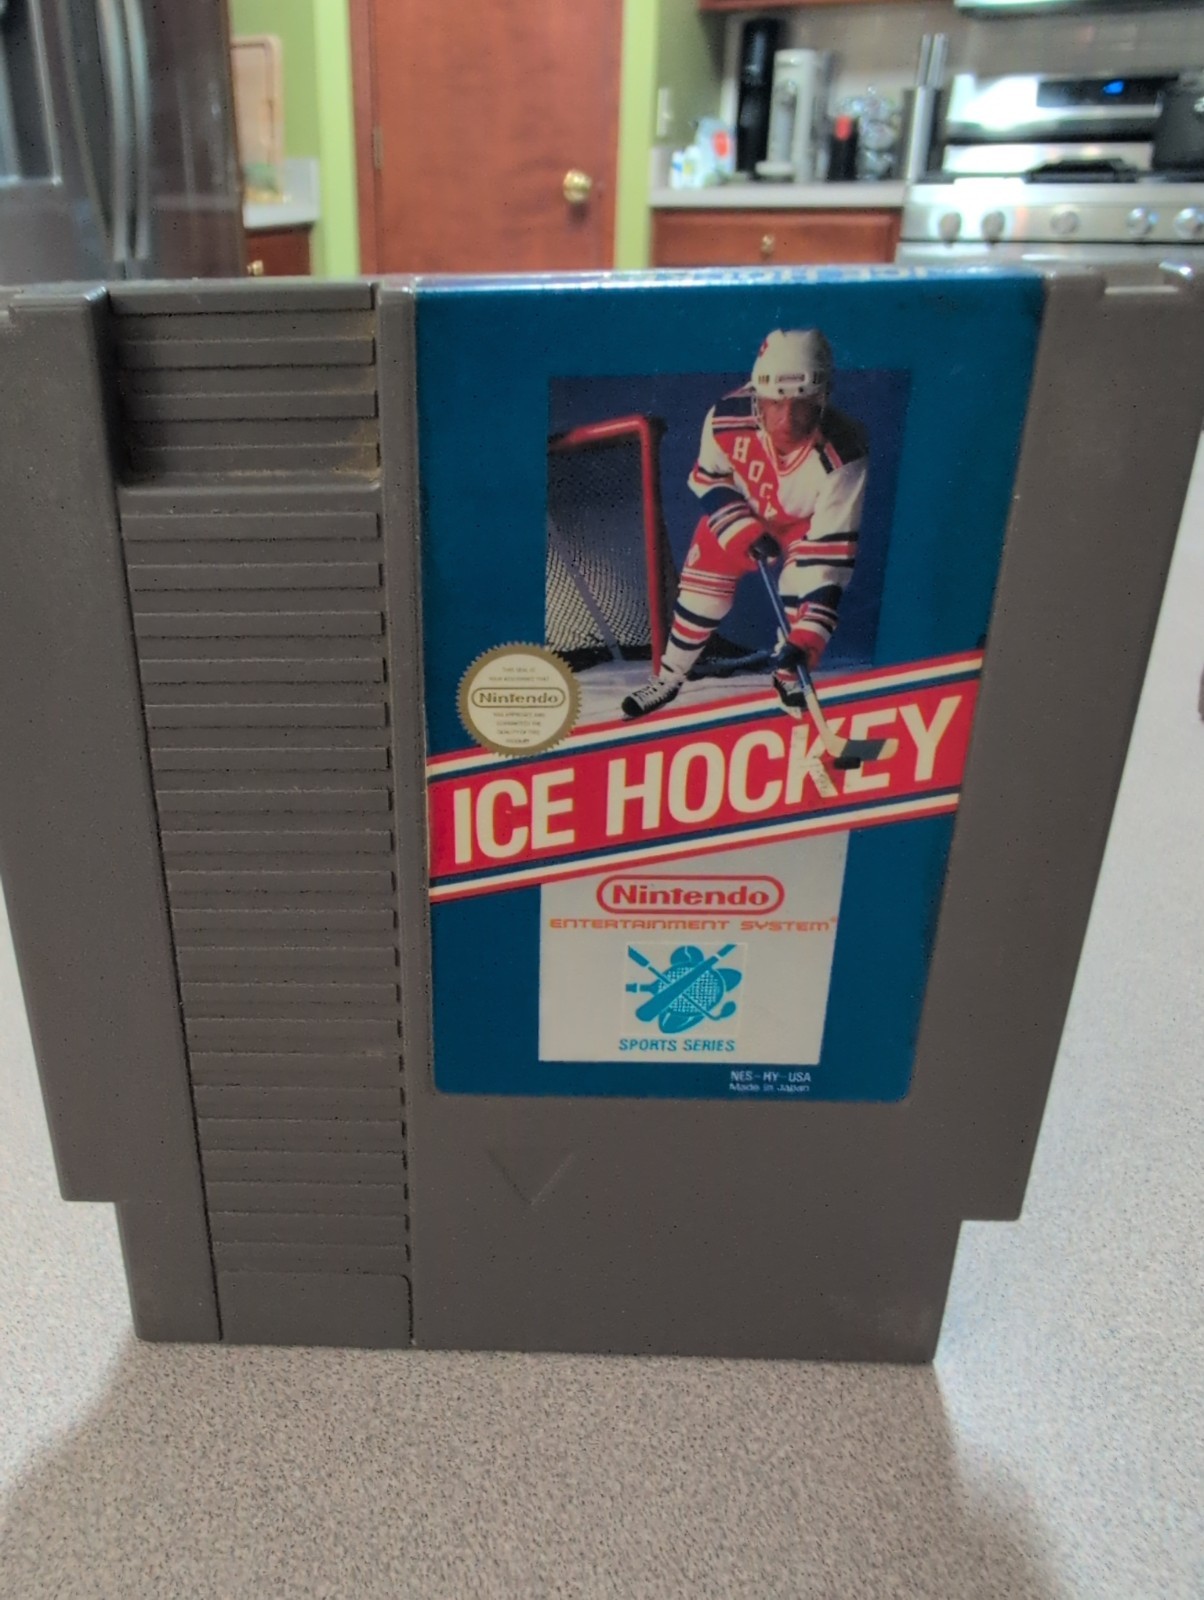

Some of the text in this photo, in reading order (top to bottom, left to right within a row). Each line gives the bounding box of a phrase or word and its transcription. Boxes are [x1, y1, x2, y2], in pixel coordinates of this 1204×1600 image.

[478, 692, 559, 704] Nintendo
[453, 695, 962, 865] ICE HOCKEY
[612, 884, 770, 906] Nintendo
[549, 918, 730, 931] ENTERTAINMENT
[618, 1039, 736, 1052] SPORTS SERIES
[728, 1083, 810, 1093] Made in Japan
